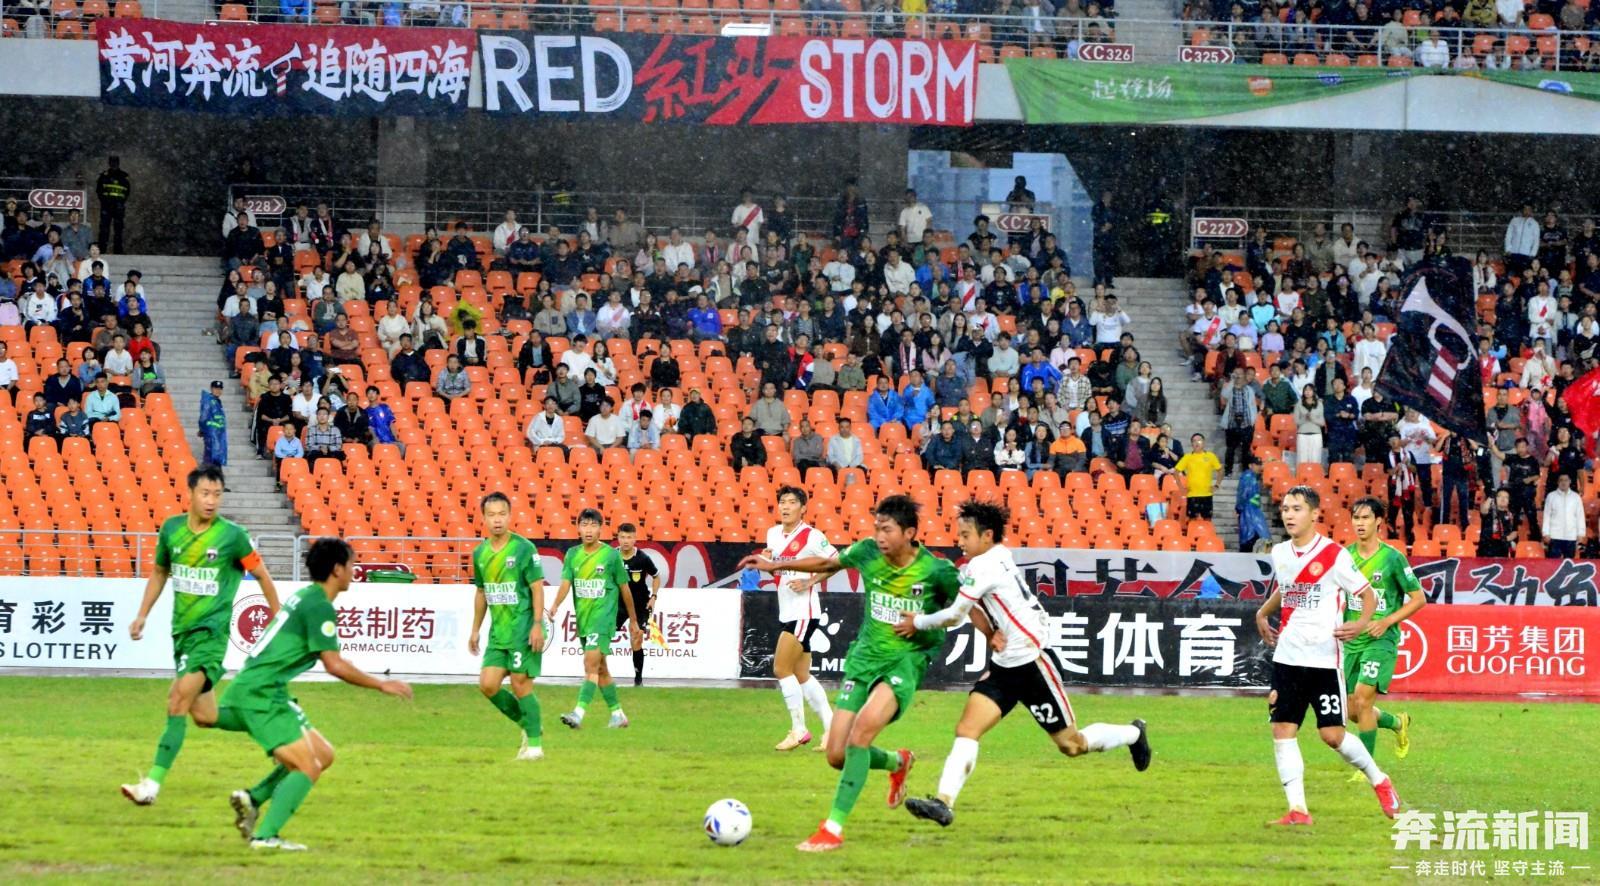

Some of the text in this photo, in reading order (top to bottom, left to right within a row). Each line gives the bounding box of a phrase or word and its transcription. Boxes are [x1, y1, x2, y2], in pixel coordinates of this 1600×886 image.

[1094, 42, 1131, 61] C326
[1182, 47, 1219, 64] C325
[101, 27, 472, 103] 黄河奔流 追随四海
[481, 34, 634, 113] RED
[800, 39, 977, 123] STORM
[44, 191, 81, 207] C229
[247, 200, 271, 213] 228
[1196, 220, 1233, 236] C227
[338, 643, 433, 654] ARMACEUTICAL
[1447, 625, 1585, 655] 国芳集团
[13, 642, 118, 660] LOTTERY
[512, 651, 523, 669] 3
[1361, 660, 1381, 679] 55
[1446, 655, 1586, 676] GUOFANG
[1030, 702, 1060, 724] 52
[1319, 694, 1341, 715] 33
